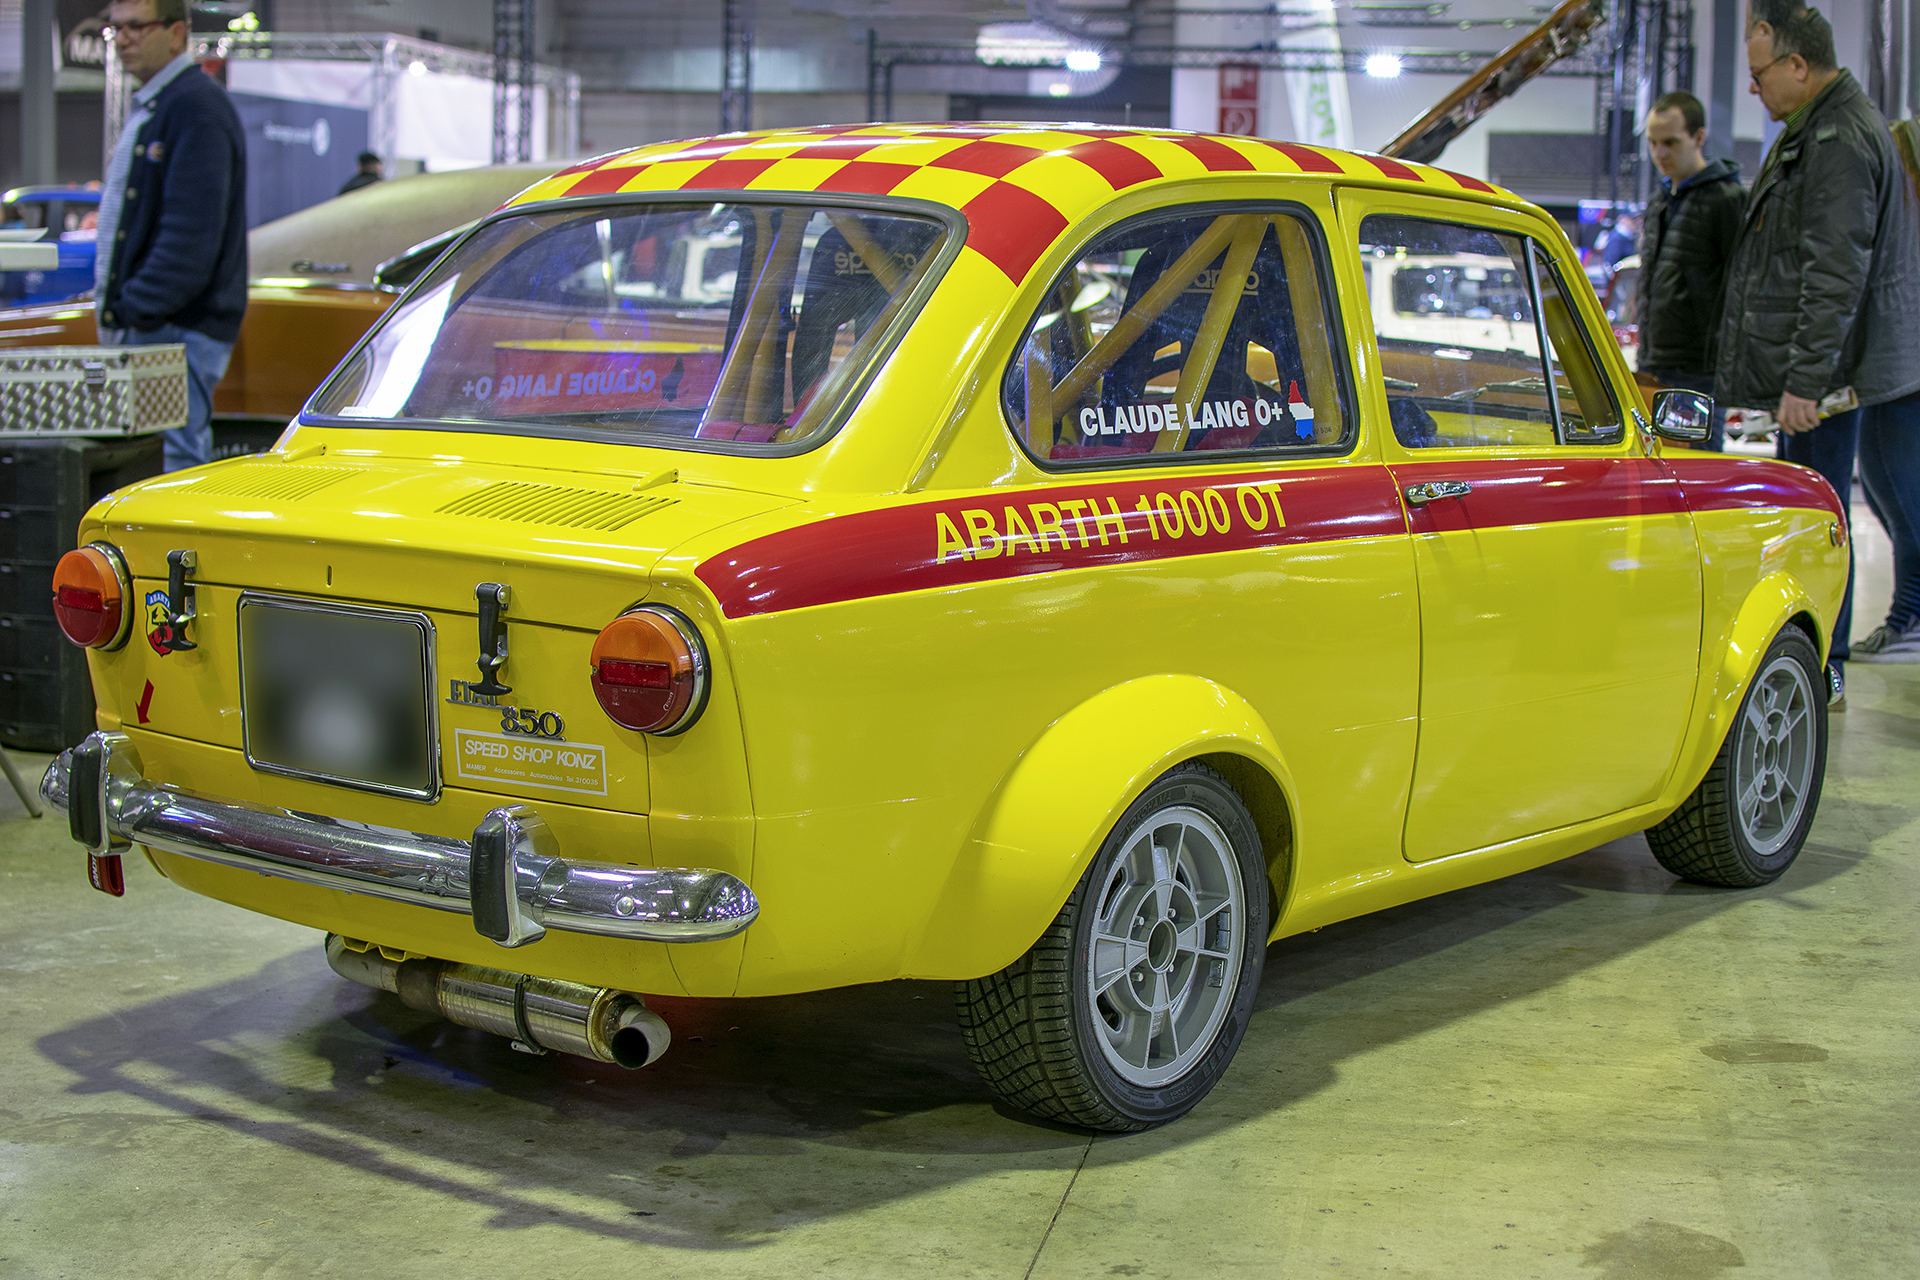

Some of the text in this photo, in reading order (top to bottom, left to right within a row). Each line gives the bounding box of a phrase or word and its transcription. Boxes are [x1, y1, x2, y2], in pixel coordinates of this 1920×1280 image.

[833, 251, 918, 275] spco
[1158, 268, 1260, 290] aro
[1079, 402, 1181, 437] CLAUDE
[1185, 400, 1249, 430] LANG
[935, 483, 1287, 565] ABARTH 1000 OT
[149, 592, 170, 609] ABART
[500, 706, 565, 737] 850
[464, 739, 597, 770] SPEED SHOP KONZ
[465, 762, 487, 772] MAMER
[493, 767, 526, 777] Accessoires
[529, 771, 563, 782] Automobiles
